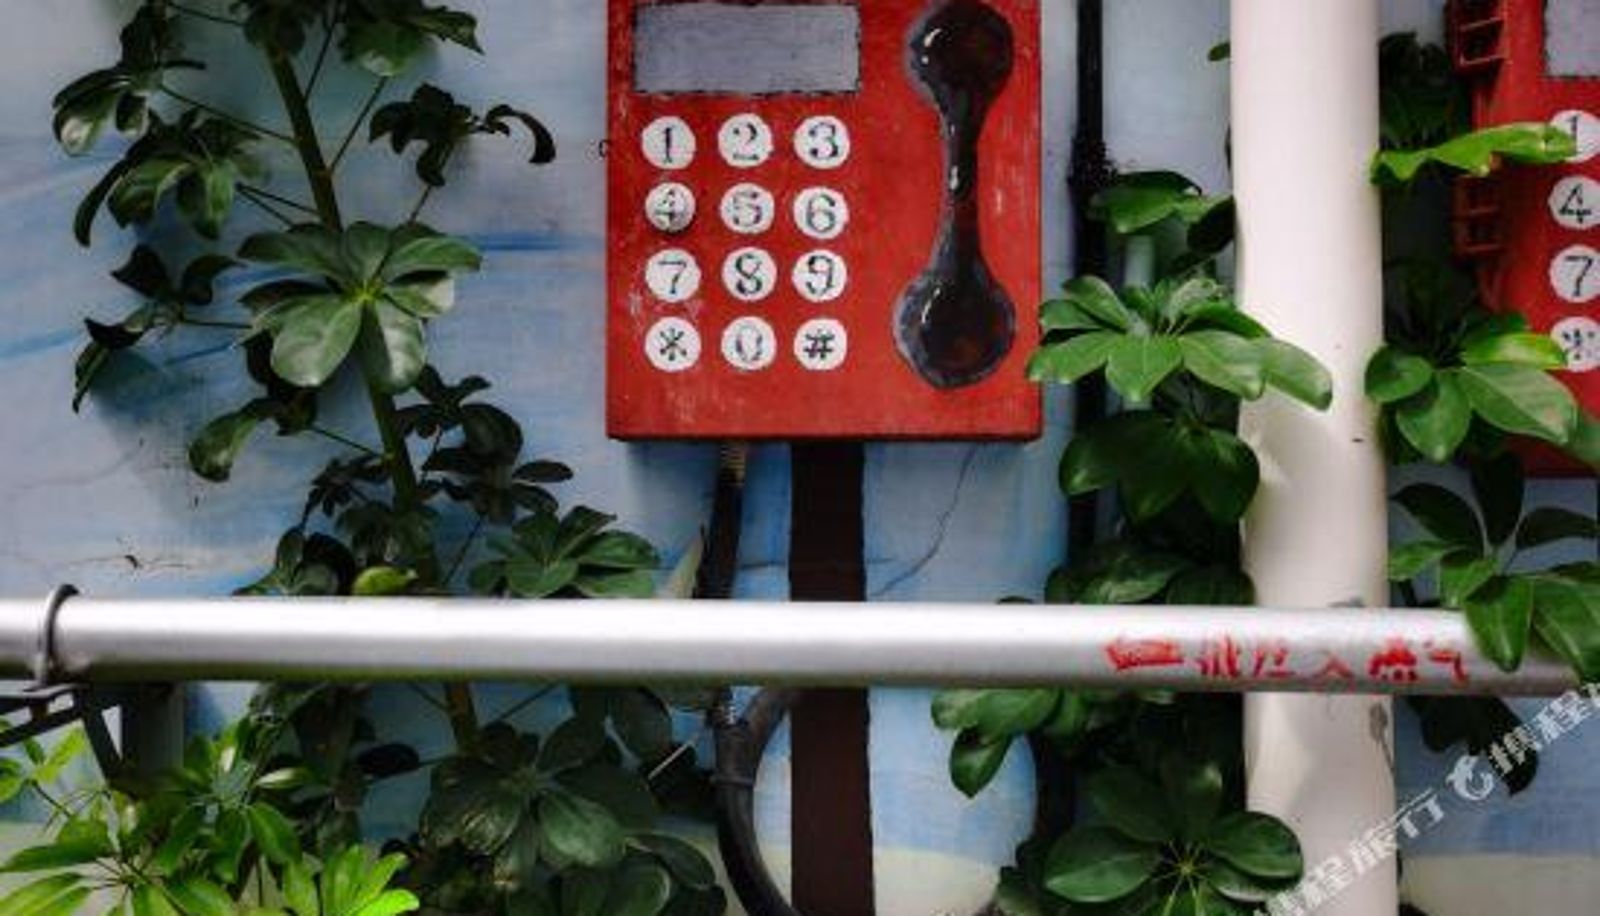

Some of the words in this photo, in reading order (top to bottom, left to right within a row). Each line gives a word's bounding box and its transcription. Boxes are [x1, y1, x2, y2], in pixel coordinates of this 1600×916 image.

[731, 122, 767, 162] 2
[807, 121, 840, 162] 3
[653, 188, 683, 231] 4
[731, 190, 764, 228] 5
[805, 192, 837, 234] 6
[1557, 182, 1593, 225] 4
[657, 259, 688, 296] 7
[734, 251, 764, 298] 8
[806, 253, 836, 296] 9
[1564, 254, 1594, 298] 7
[734, 324, 764, 363] 0
